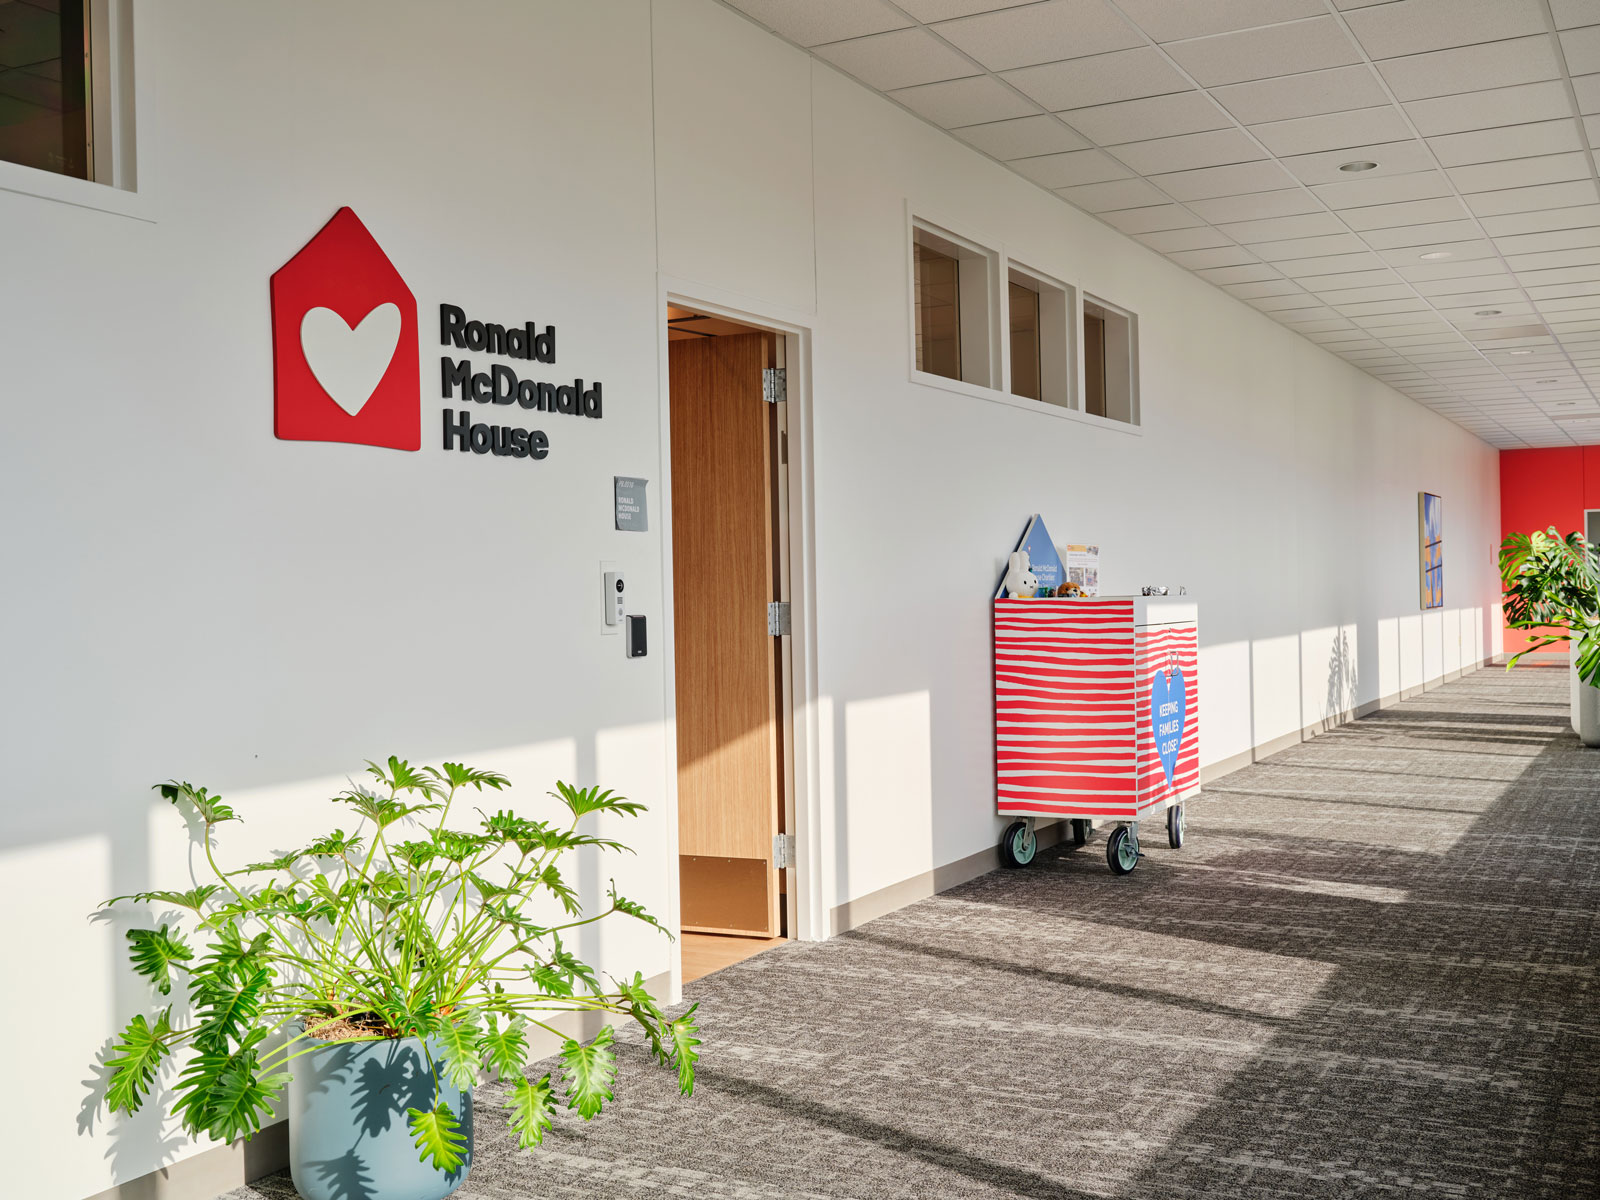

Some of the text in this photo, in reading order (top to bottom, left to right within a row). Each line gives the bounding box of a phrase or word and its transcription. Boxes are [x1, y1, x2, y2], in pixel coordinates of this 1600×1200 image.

[440, 303, 556, 364] Ronald
[441, 356, 603, 419] McDonald
[443, 408, 549, 460] House
[1159, 719, 1179, 736] FAMILIES
[1160, 701, 1178, 717] KEEPING
